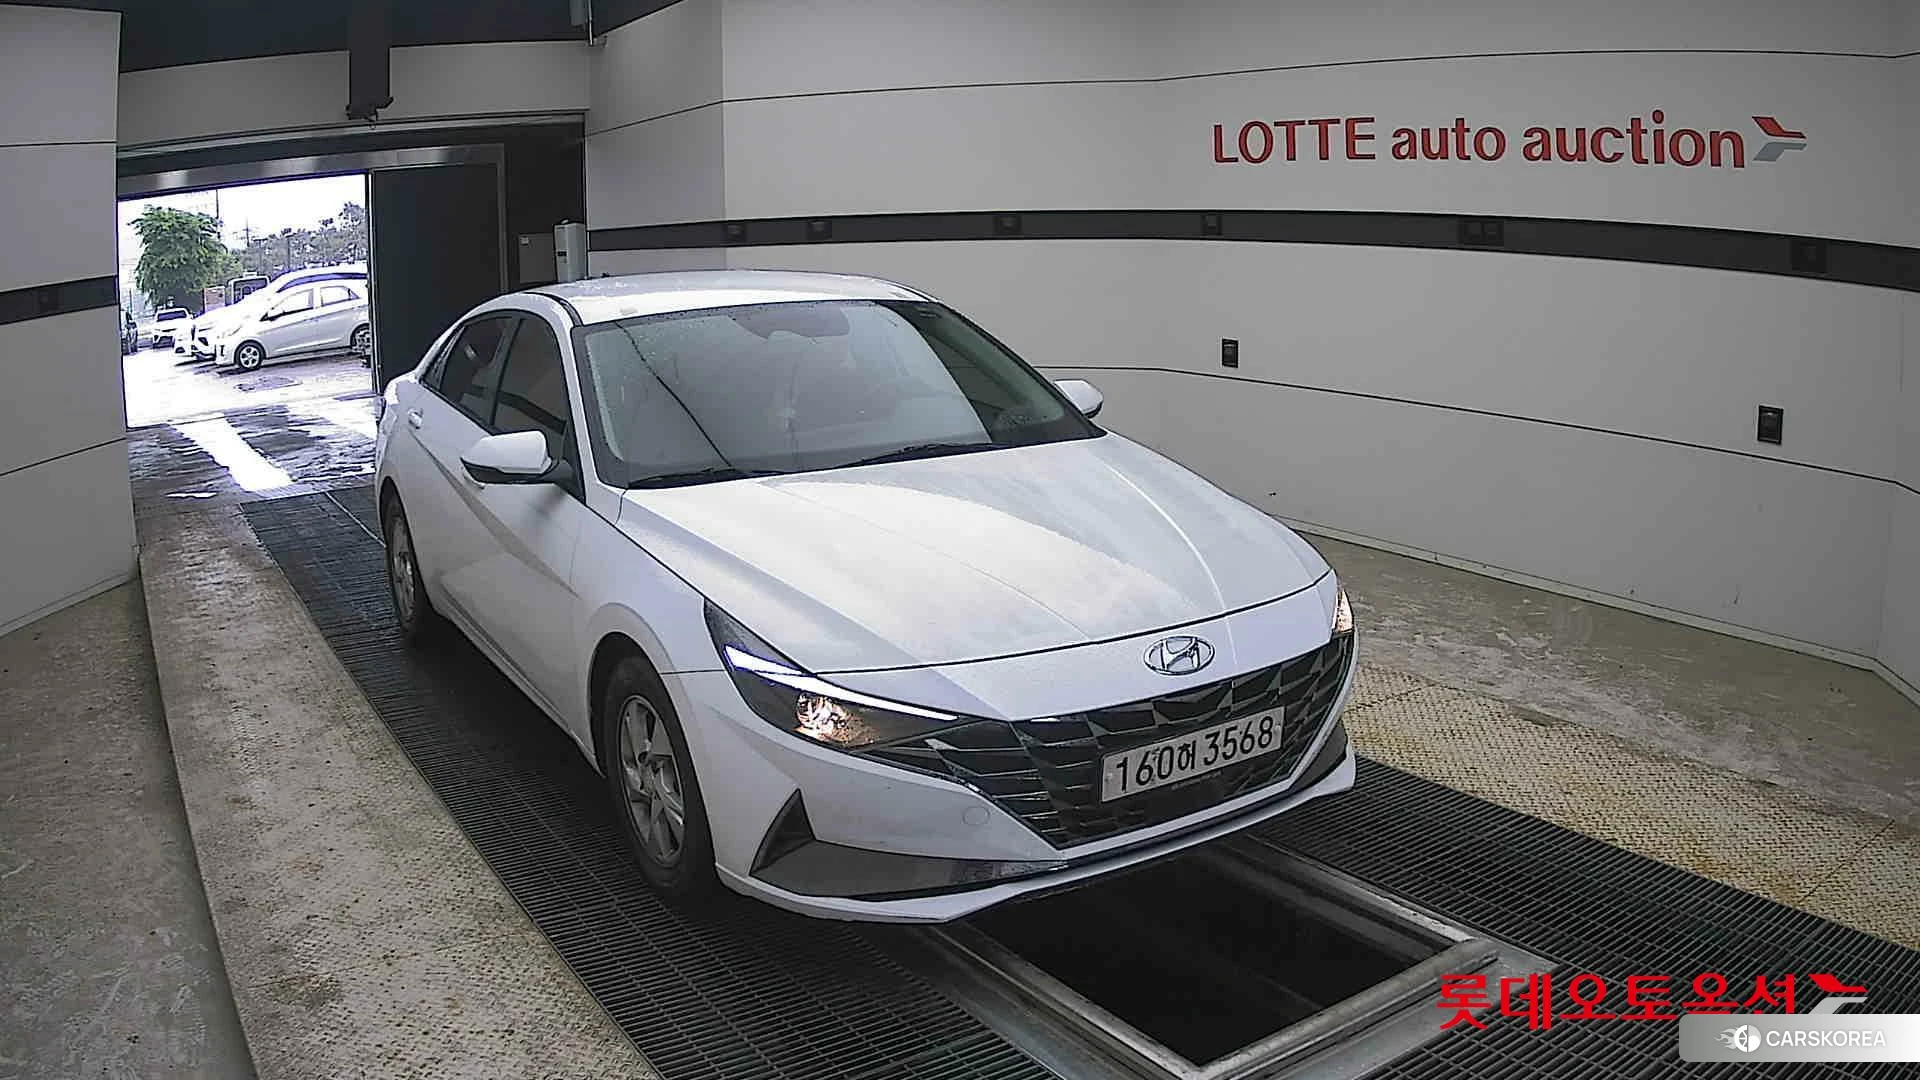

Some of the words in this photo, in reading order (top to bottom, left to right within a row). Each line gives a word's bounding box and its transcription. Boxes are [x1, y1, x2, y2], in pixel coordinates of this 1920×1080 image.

[1212, 117, 1377, 164] LOTTE
[1391, 118, 1507, 161] auto
[1522, 109, 1746, 168] auction
[1203, 715, 1275, 766] 3568
